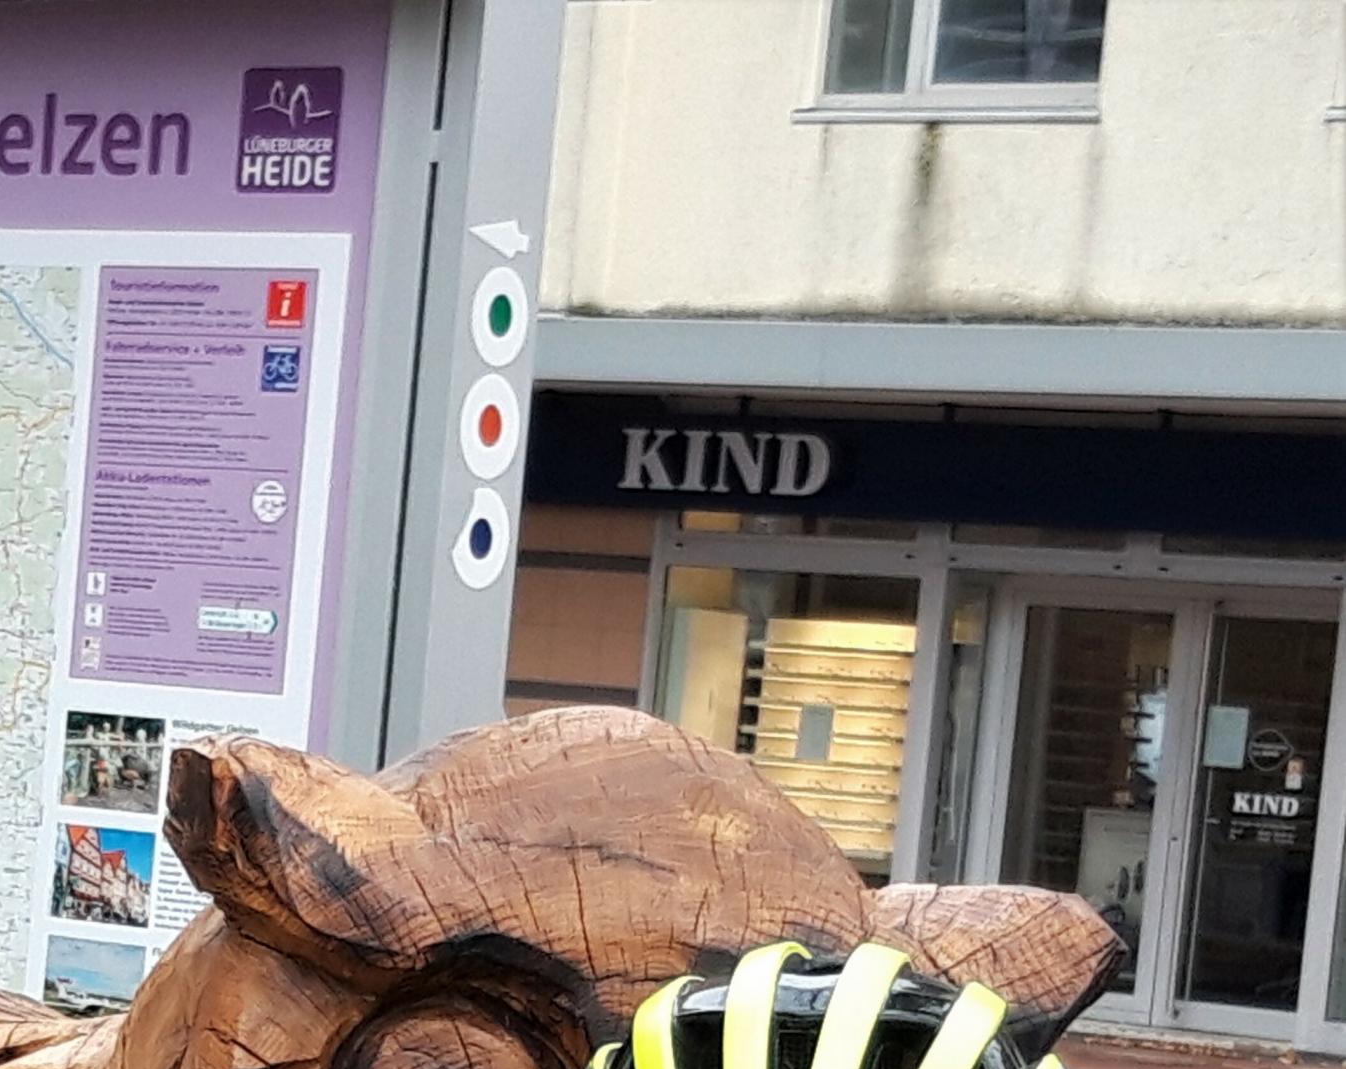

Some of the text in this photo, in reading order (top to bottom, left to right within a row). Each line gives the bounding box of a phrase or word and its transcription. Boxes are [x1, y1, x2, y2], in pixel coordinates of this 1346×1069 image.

[241, 154, 333, 186] HEIDE
[616, 427, 831, 497] KIND
[1232, 792, 1300, 818] KIND
